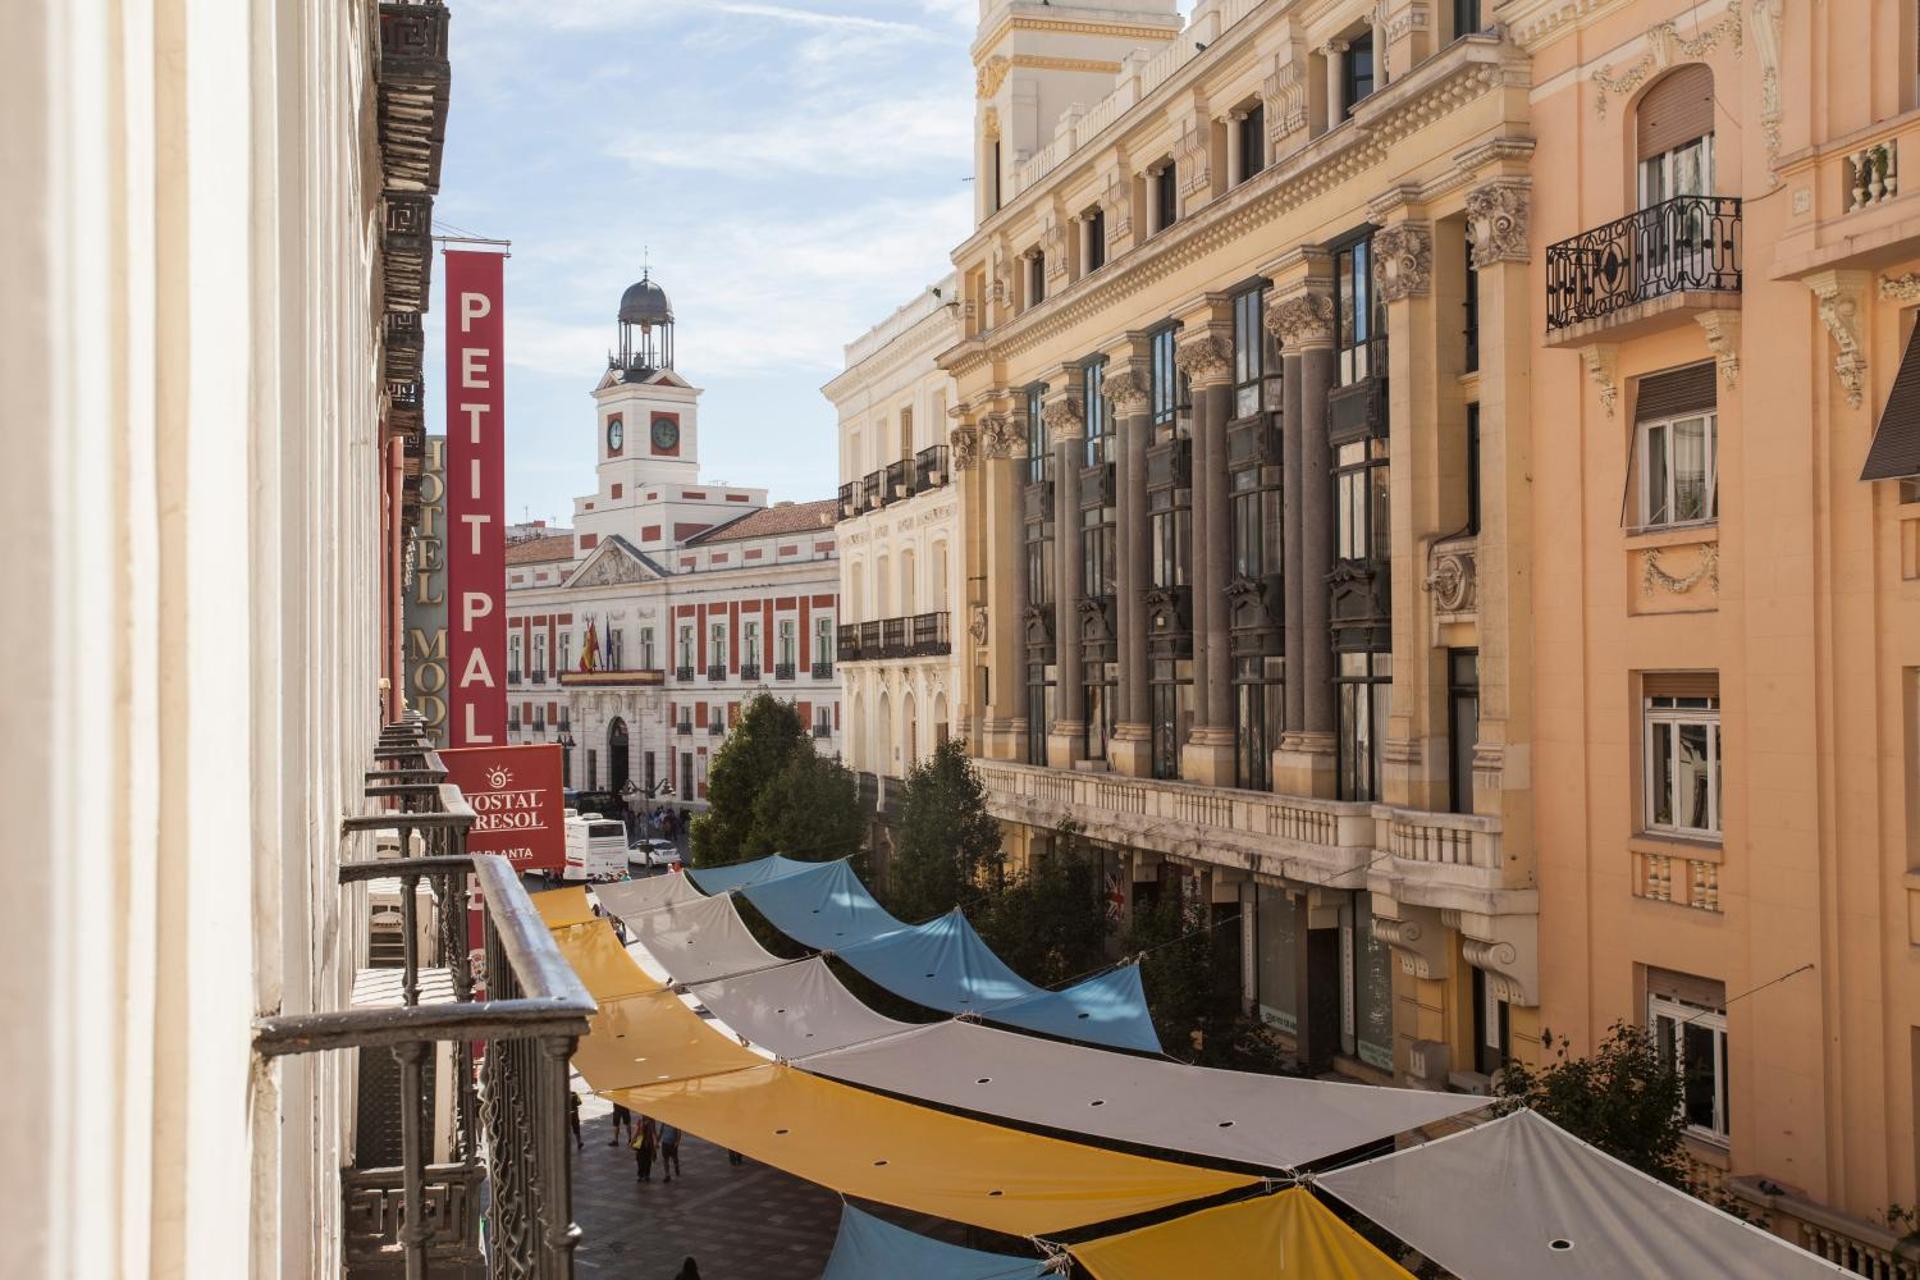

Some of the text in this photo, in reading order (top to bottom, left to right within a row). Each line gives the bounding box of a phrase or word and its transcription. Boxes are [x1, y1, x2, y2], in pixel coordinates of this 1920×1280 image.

[459, 292, 495, 743] PETIT PAL
[410, 628, 449, 738] MOD
[471, 811, 544, 830] RESOL
